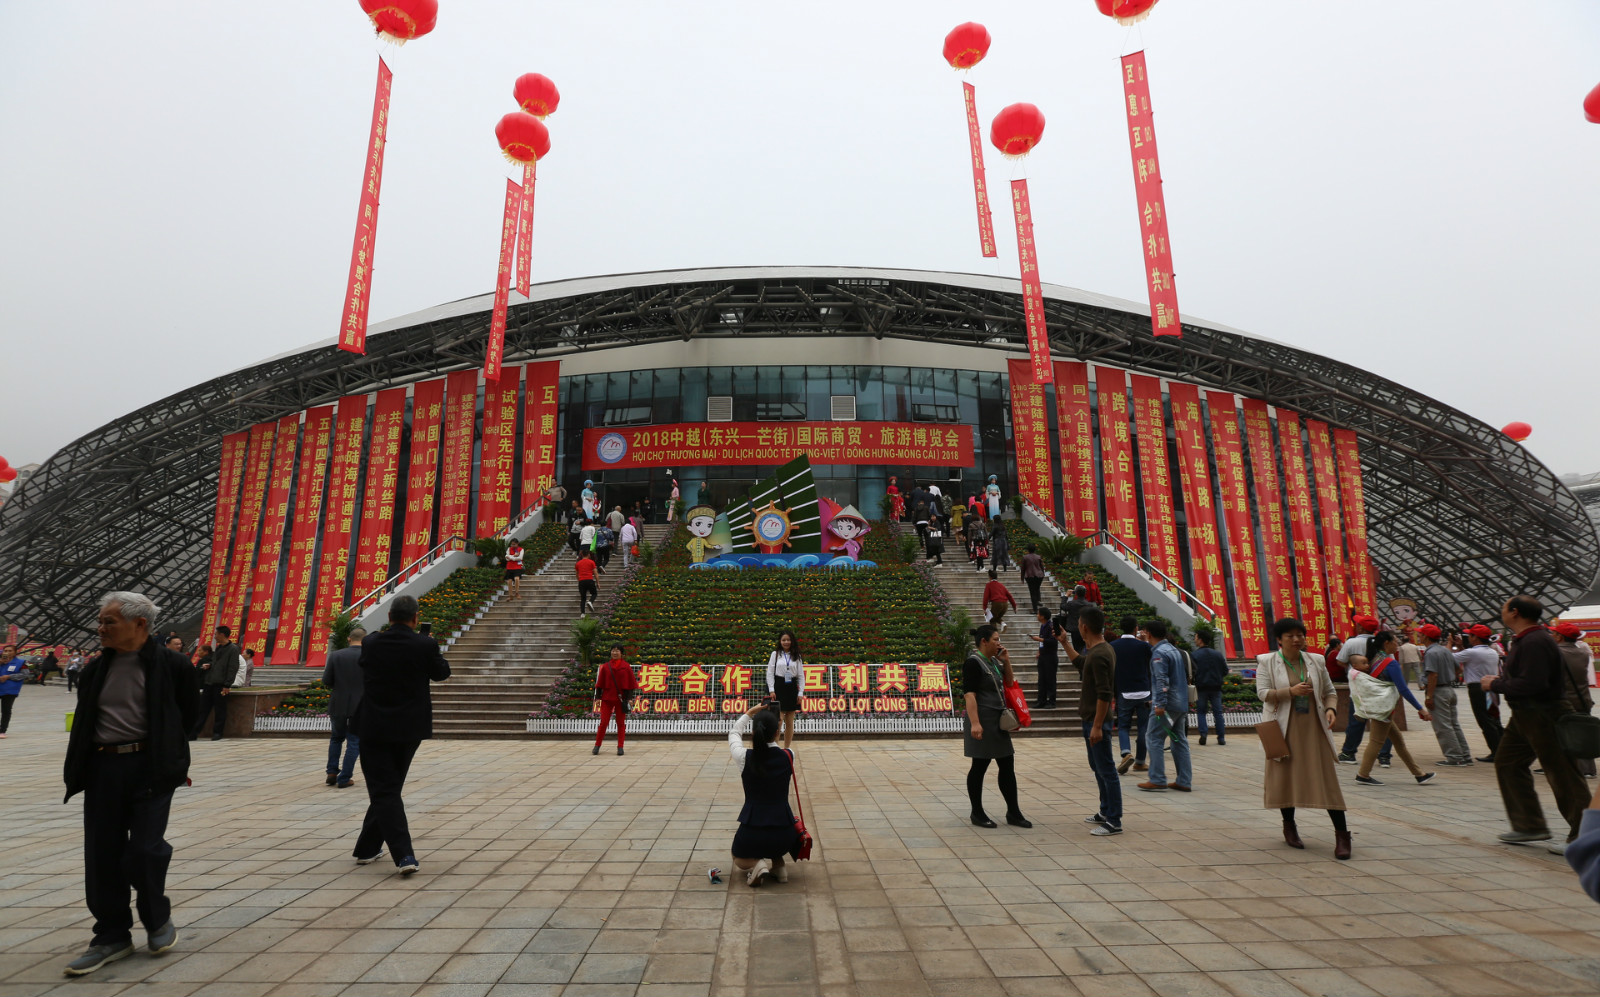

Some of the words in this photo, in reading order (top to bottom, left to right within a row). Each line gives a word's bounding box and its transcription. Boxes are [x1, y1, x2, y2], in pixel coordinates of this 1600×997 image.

[307, 418, 331, 524] 五湖四海汇东兴
[341, 417, 364, 533] 建设陆海新通道
[379, 411, 402, 521] 共建海上新丝路
[421, 402, 441, 512] 树国门形象
[494, 389, 517, 504] 试验区先行先试
[537, 385, 556, 497] 互惠互利
[723, 449, 734, 459] DU
[943, 450, 959, 460] 2018
[1028, 382, 1051, 500] 共建陆海丝路经济带
[1073, 384, 1093, 500] 同一个目标携手共进
[1111, 391, 1133, 503] 跨境合作
[1319, 429, 1340, 531] 中越友谊
[1185, 401, 1210, 509] 海上丝路
[1202, 522, 1231, 639] 扬帆远航
[1222, 410, 1248, 513] 一带一路促发展
[1241, 526, 1265, 642] 无限商机在东兴
[1287, 421, 1311, 525] 携手跨境合作
[1305, 538, 1328, 648] 共享发展成果
[632, 696, 650, 713] ÁC
[654, 698, 680, 713] QUA
[687, 696, 716, 713] BIÊN
[722, 696, 749, 713] GIỚI
[801, 696, 828, 713] ÙNG
[828, 695, 847, 713] CÓ
[849, 697, 871, 714] LỢI
[873, 695, 908, 713] CÙNG
[911, 694, 952, 713] THẮNG
[637, 663, 752, 695] 境合作
[803, 662, 950, 694] 互利共赢
